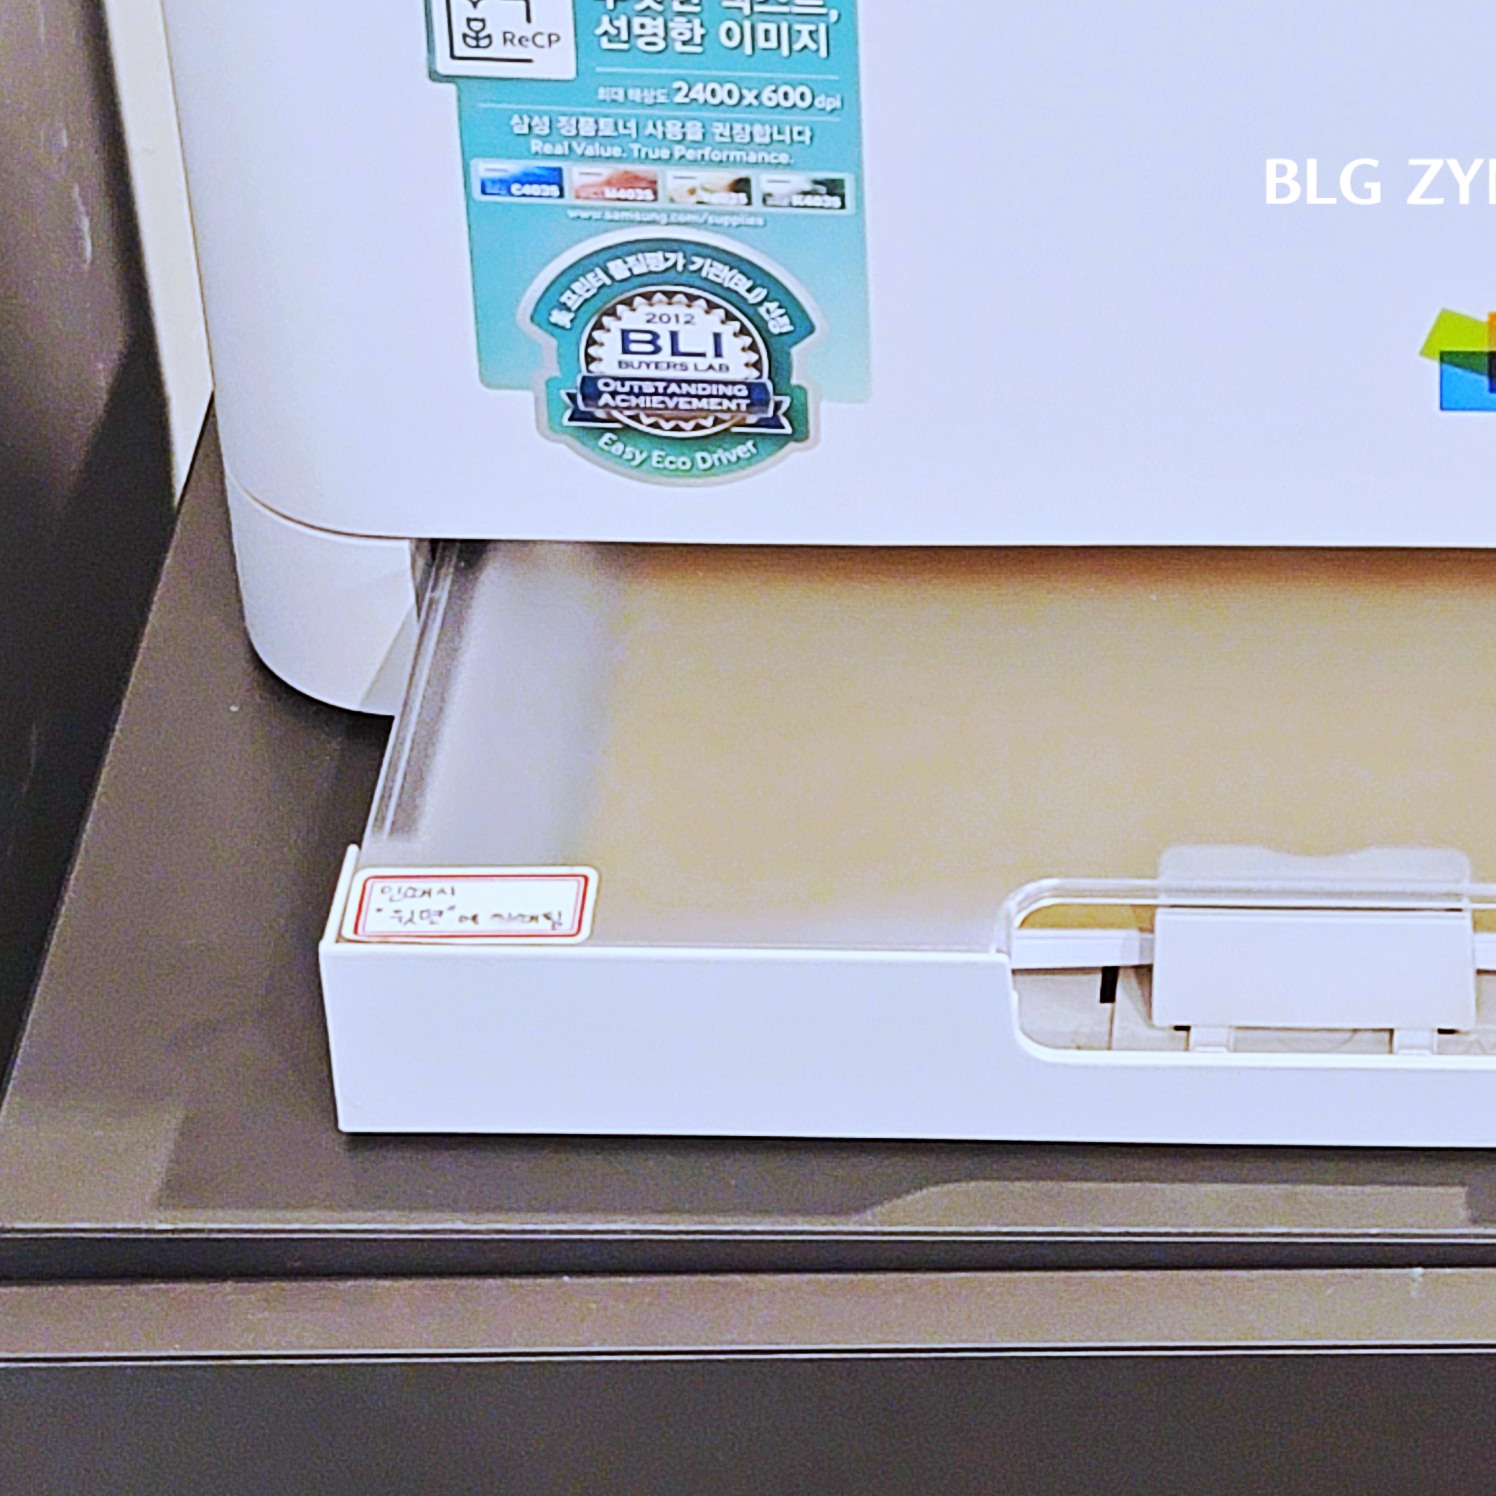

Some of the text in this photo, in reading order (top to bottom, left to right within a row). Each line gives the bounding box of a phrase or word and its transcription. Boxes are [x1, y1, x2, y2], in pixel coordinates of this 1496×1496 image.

[502, 30, 561, 50] ReCP
[594, 14, 829, 57] 선명한 이미지
[510, 114, 551, 136] 삼성
[645, 120, 704, 142] 사용을
[712, 122, 813, 145] 권장합니다
[530, 139, 795, 165] Real Value. True Performance.
[566, 208, 765, 226] www.samsung.com/supplies
[559, 266, 612, 311] 프린터
[645, 313, 697, 325] 2012
[620, 328, 723, 358] BLI
[617, 360, 730, 373] BUYERS LAB
[597, 378, 749, 397] OUTSTANDING
[597, 392, 751, 412] ACHIEVEMENT
[598, 432, 758, 470] Easy Eco Driver
